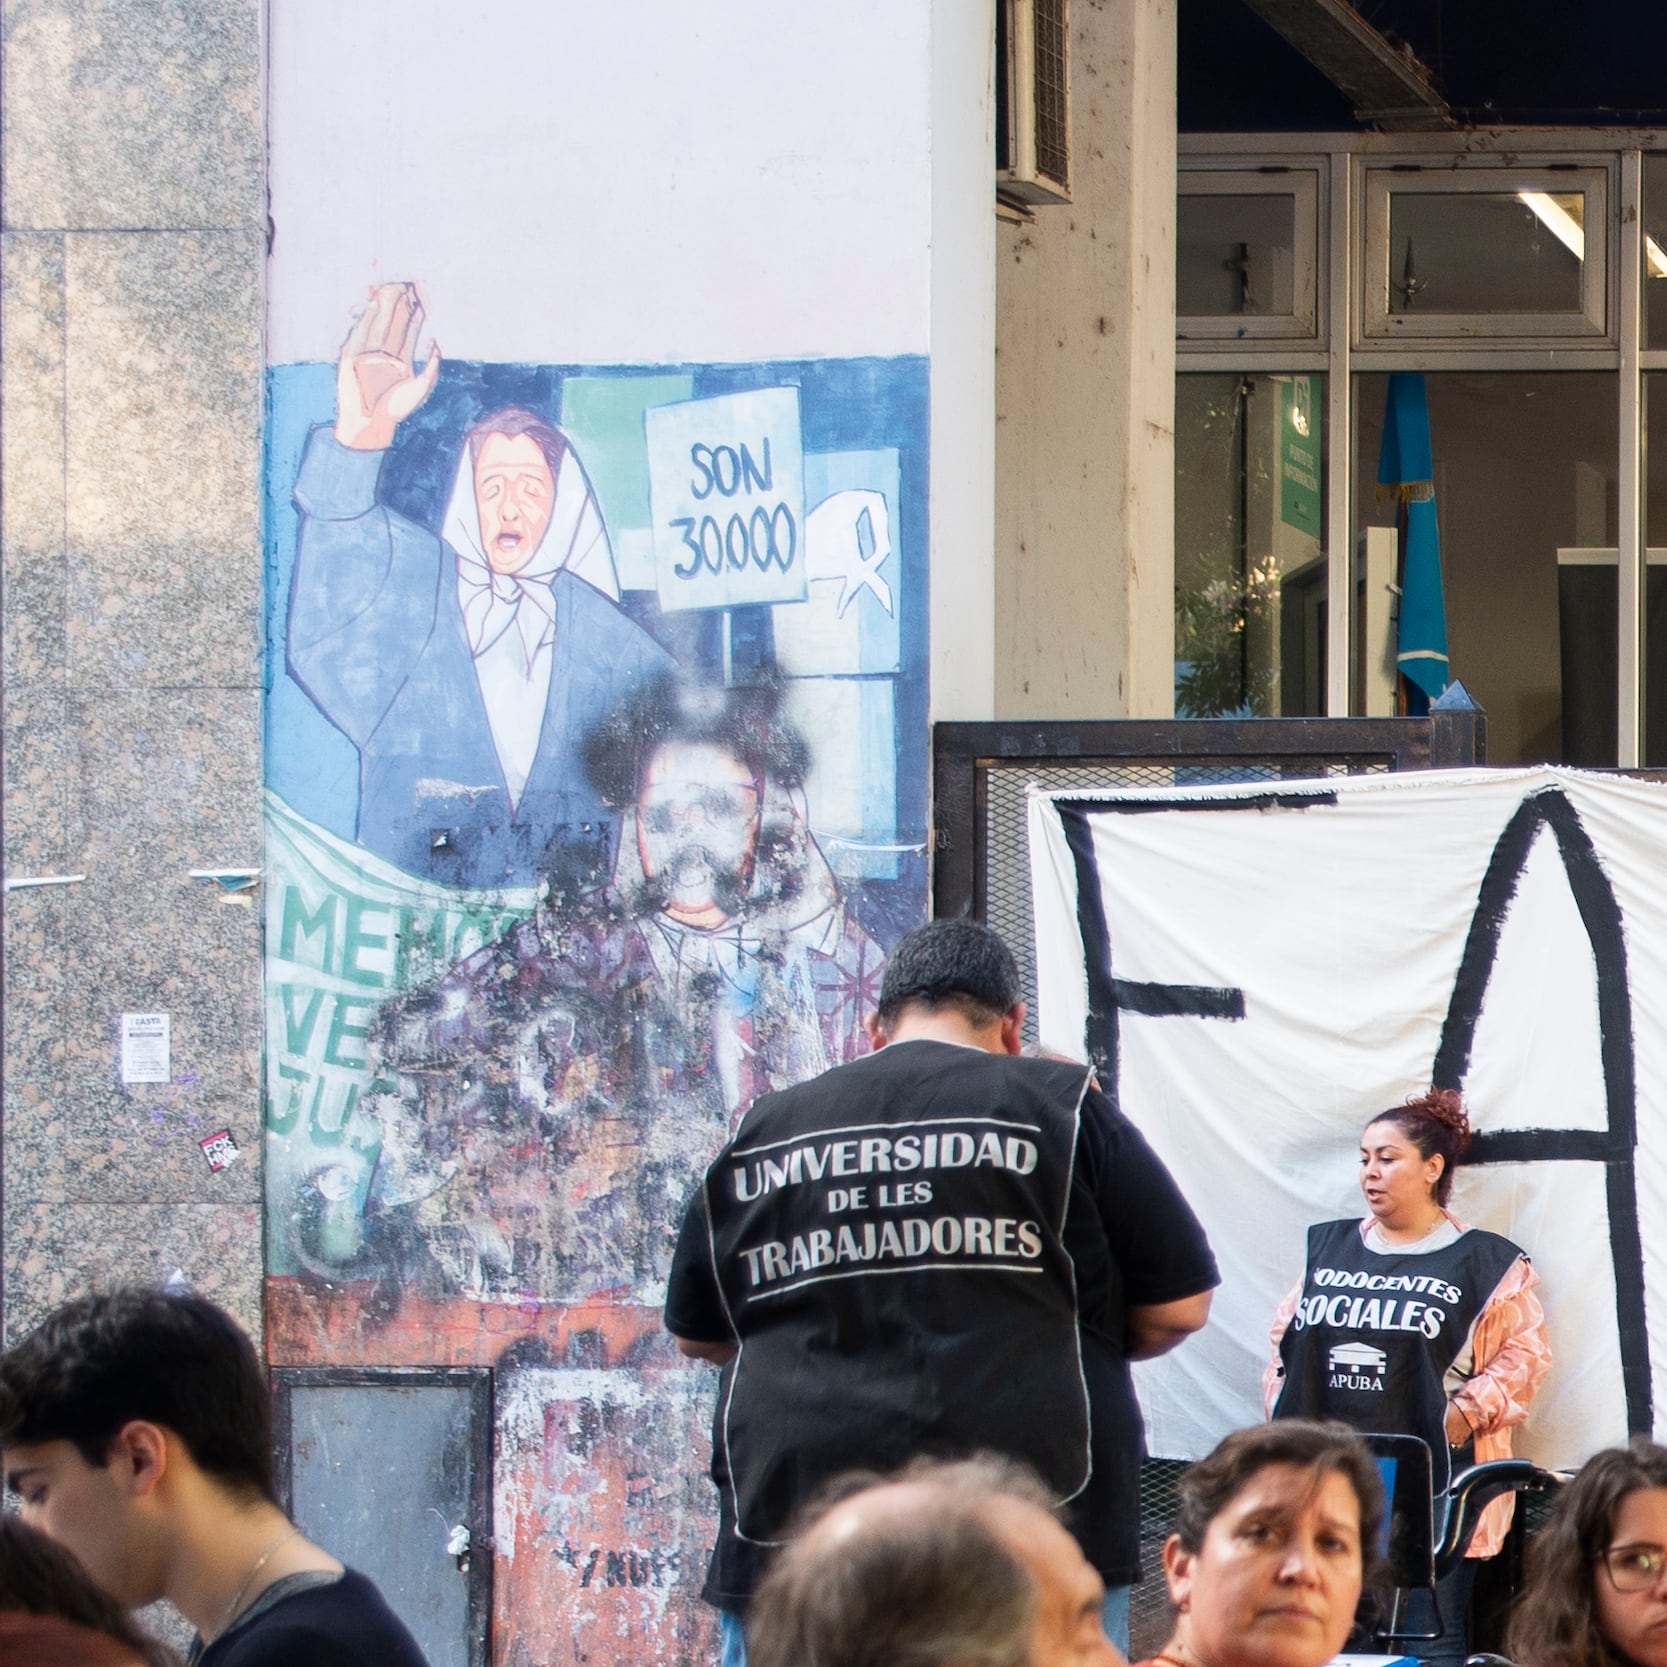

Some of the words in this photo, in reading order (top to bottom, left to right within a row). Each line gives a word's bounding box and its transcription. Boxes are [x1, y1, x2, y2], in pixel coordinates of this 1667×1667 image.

[690, 436, 774, 500] SON
[732, 1131, 1039, 1203] UNIVERSIDAD
[827, 1188, 869, 1214] DE
[879, 1180, 934, 1208] LES
[739, 1216, 1044, 1288] TRABAJADORES
[1313, 1267, 1462, 1304] ODOCENTES
[1294, 1294, 1446, 1340] SOCIALES
[1328, 1374, 1385, 1392] APUBA
